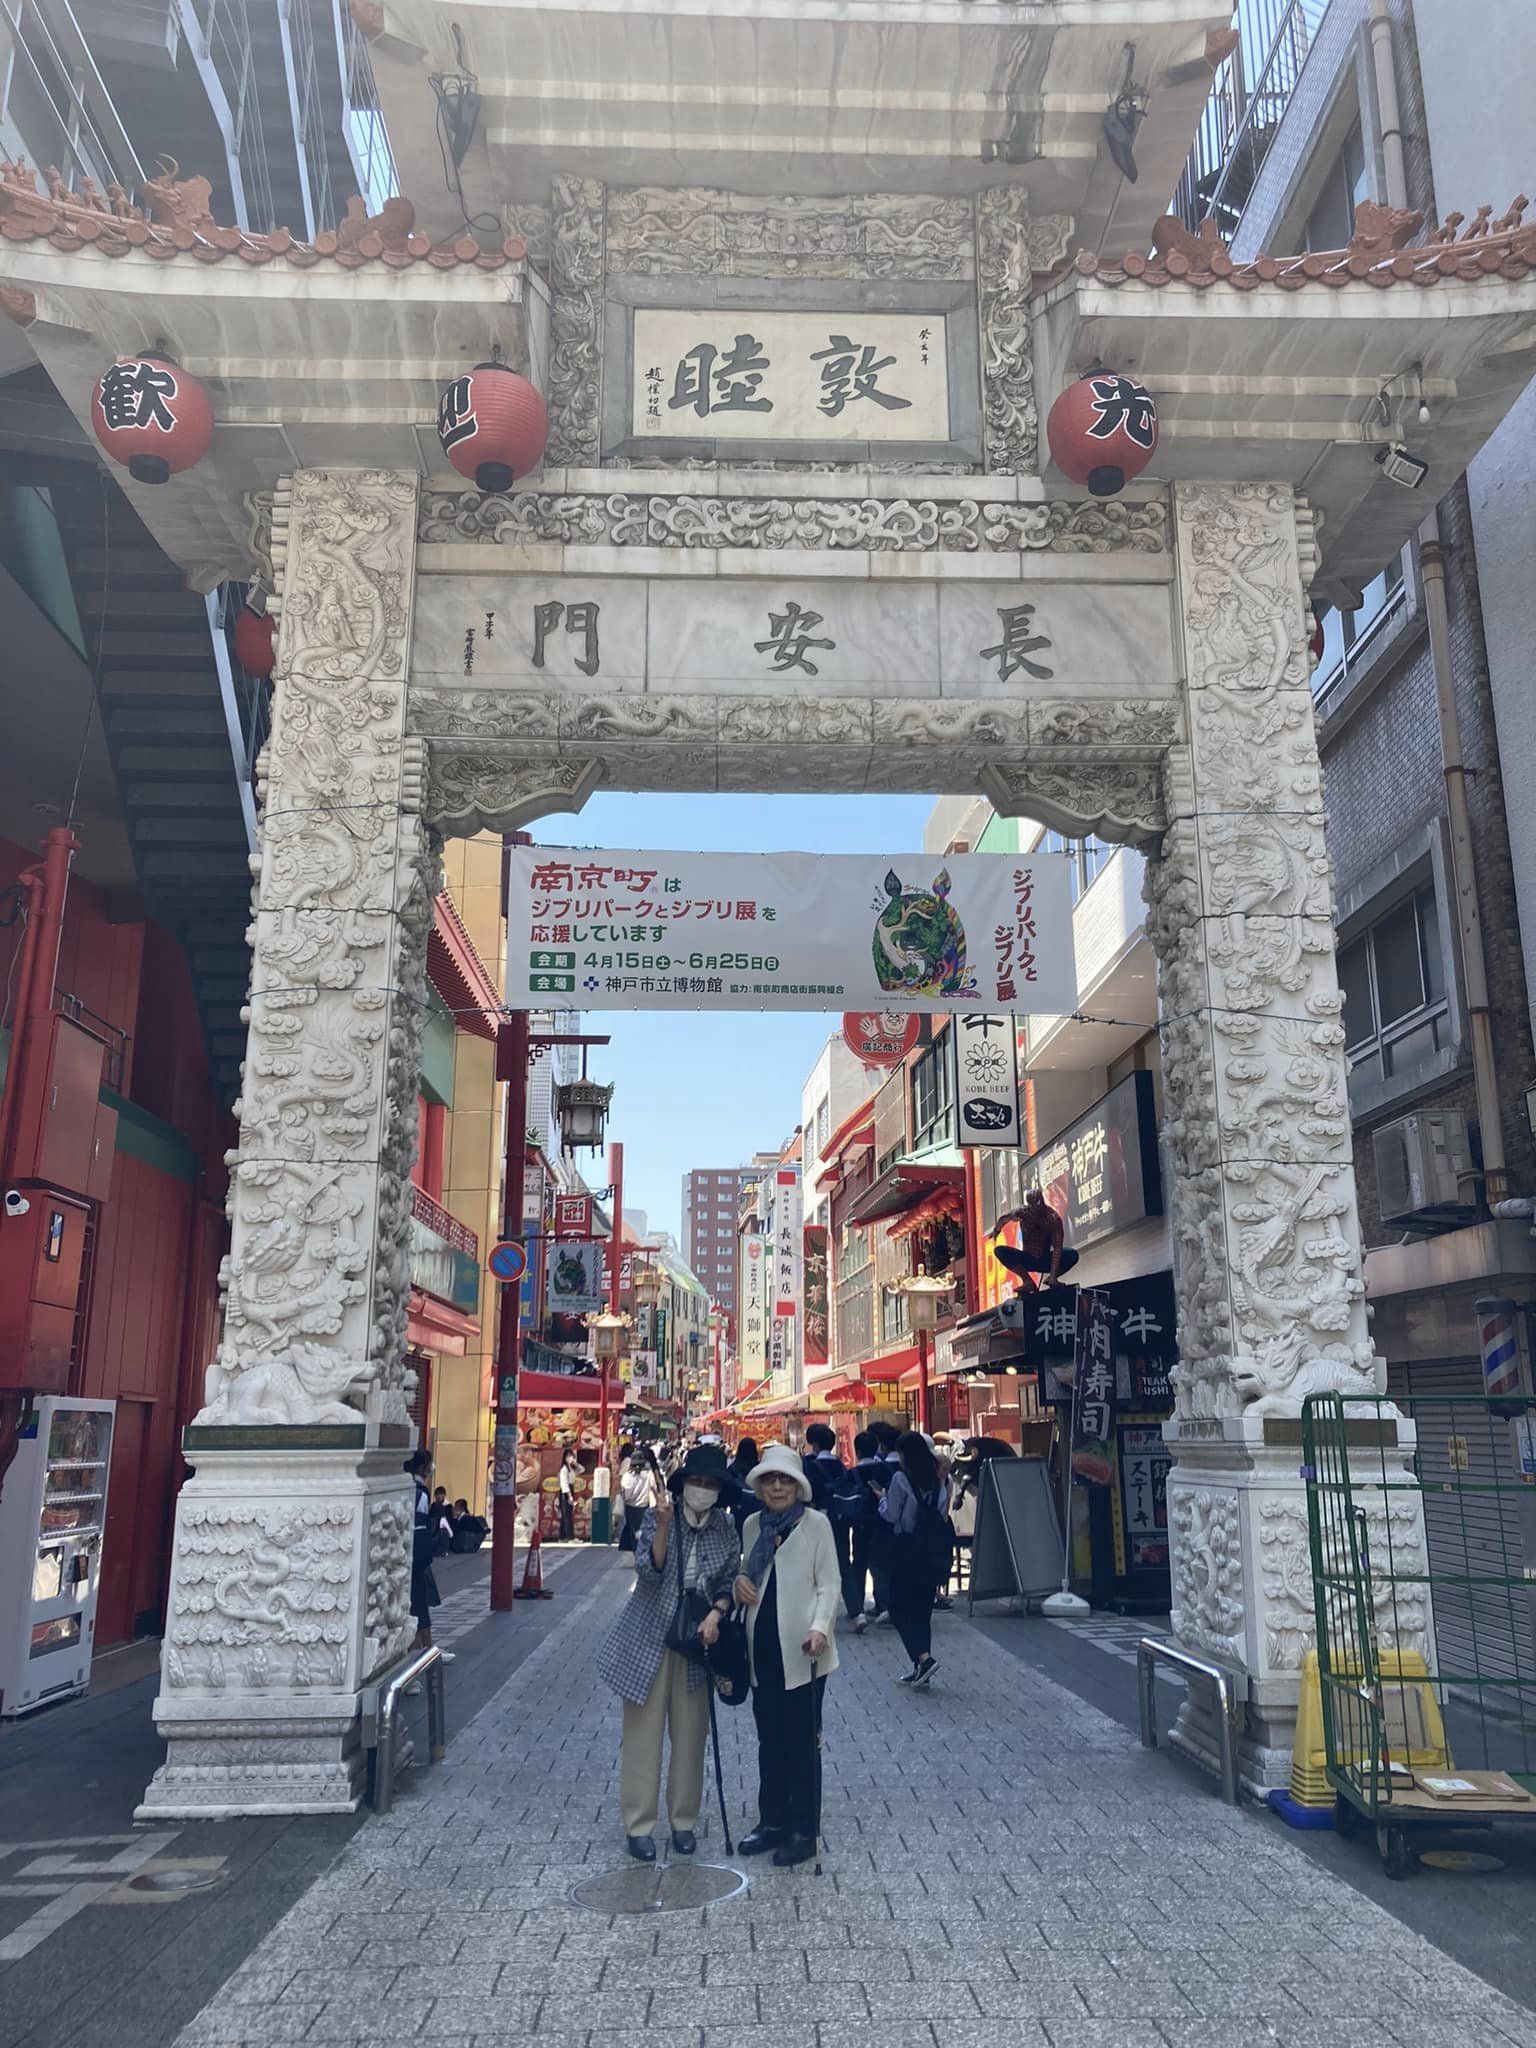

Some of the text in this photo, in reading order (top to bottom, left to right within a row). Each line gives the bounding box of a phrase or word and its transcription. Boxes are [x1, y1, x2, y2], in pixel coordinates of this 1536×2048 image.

[100, 362, 178, 432] 歓
[1085, 375, 1156, 449] 光
[530, 925, 668, 943] 応援しています
[531, 898, 776, 921] ジブリパークとジブリ展を
[1013, 869, 1037, 981] ジブリパークと
[537, 953, 569, 967] 会期
[537, 976, 569, 990] 会場
[605, 976, 722, 993] 神戸市立博物館
[995, 925, 1017, 1001] ジブリ展
[965, 1085, 987, 1094] KOBE
[1071, 1122, 1108, 1187] 神戸牛
[1130, 1460, 1150, 1528] ステーキ
